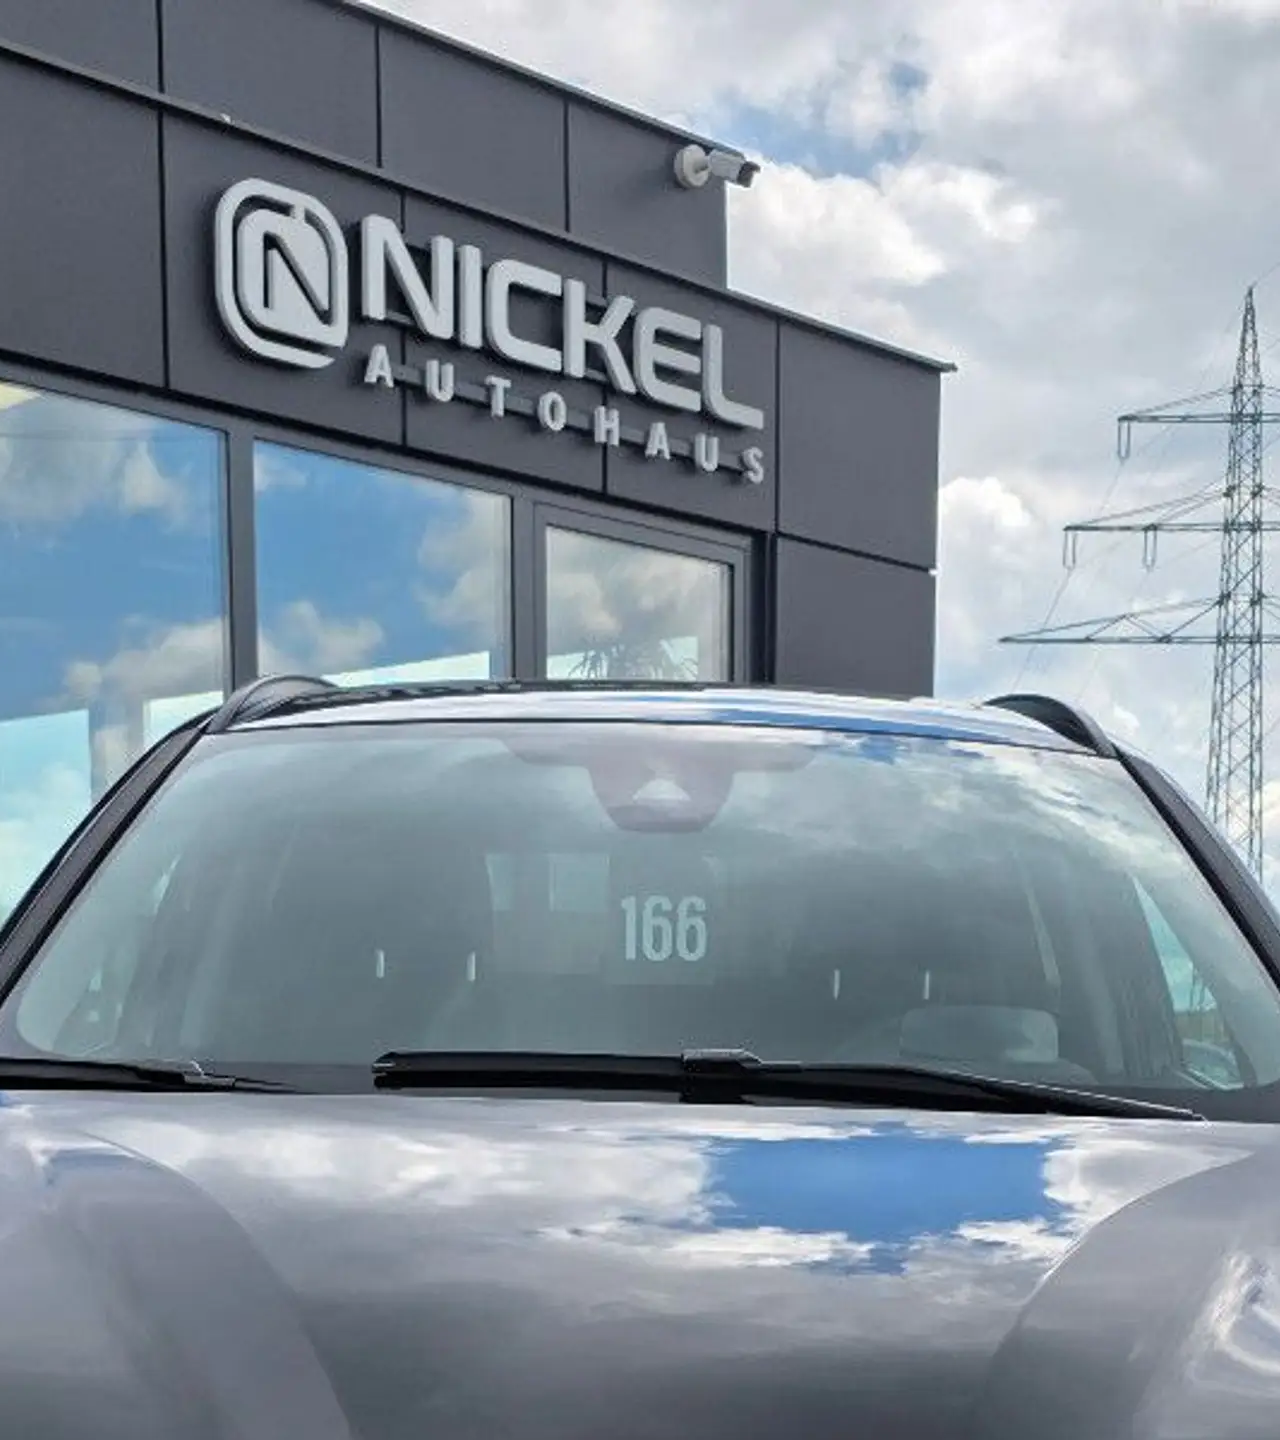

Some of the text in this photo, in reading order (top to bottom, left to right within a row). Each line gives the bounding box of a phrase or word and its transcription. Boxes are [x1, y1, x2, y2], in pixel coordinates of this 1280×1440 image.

[361, 214, 764, 429] NICKEL
[364, 344, 764, 484] AUTOHAUS
[621, 896, 707, 961] 166
